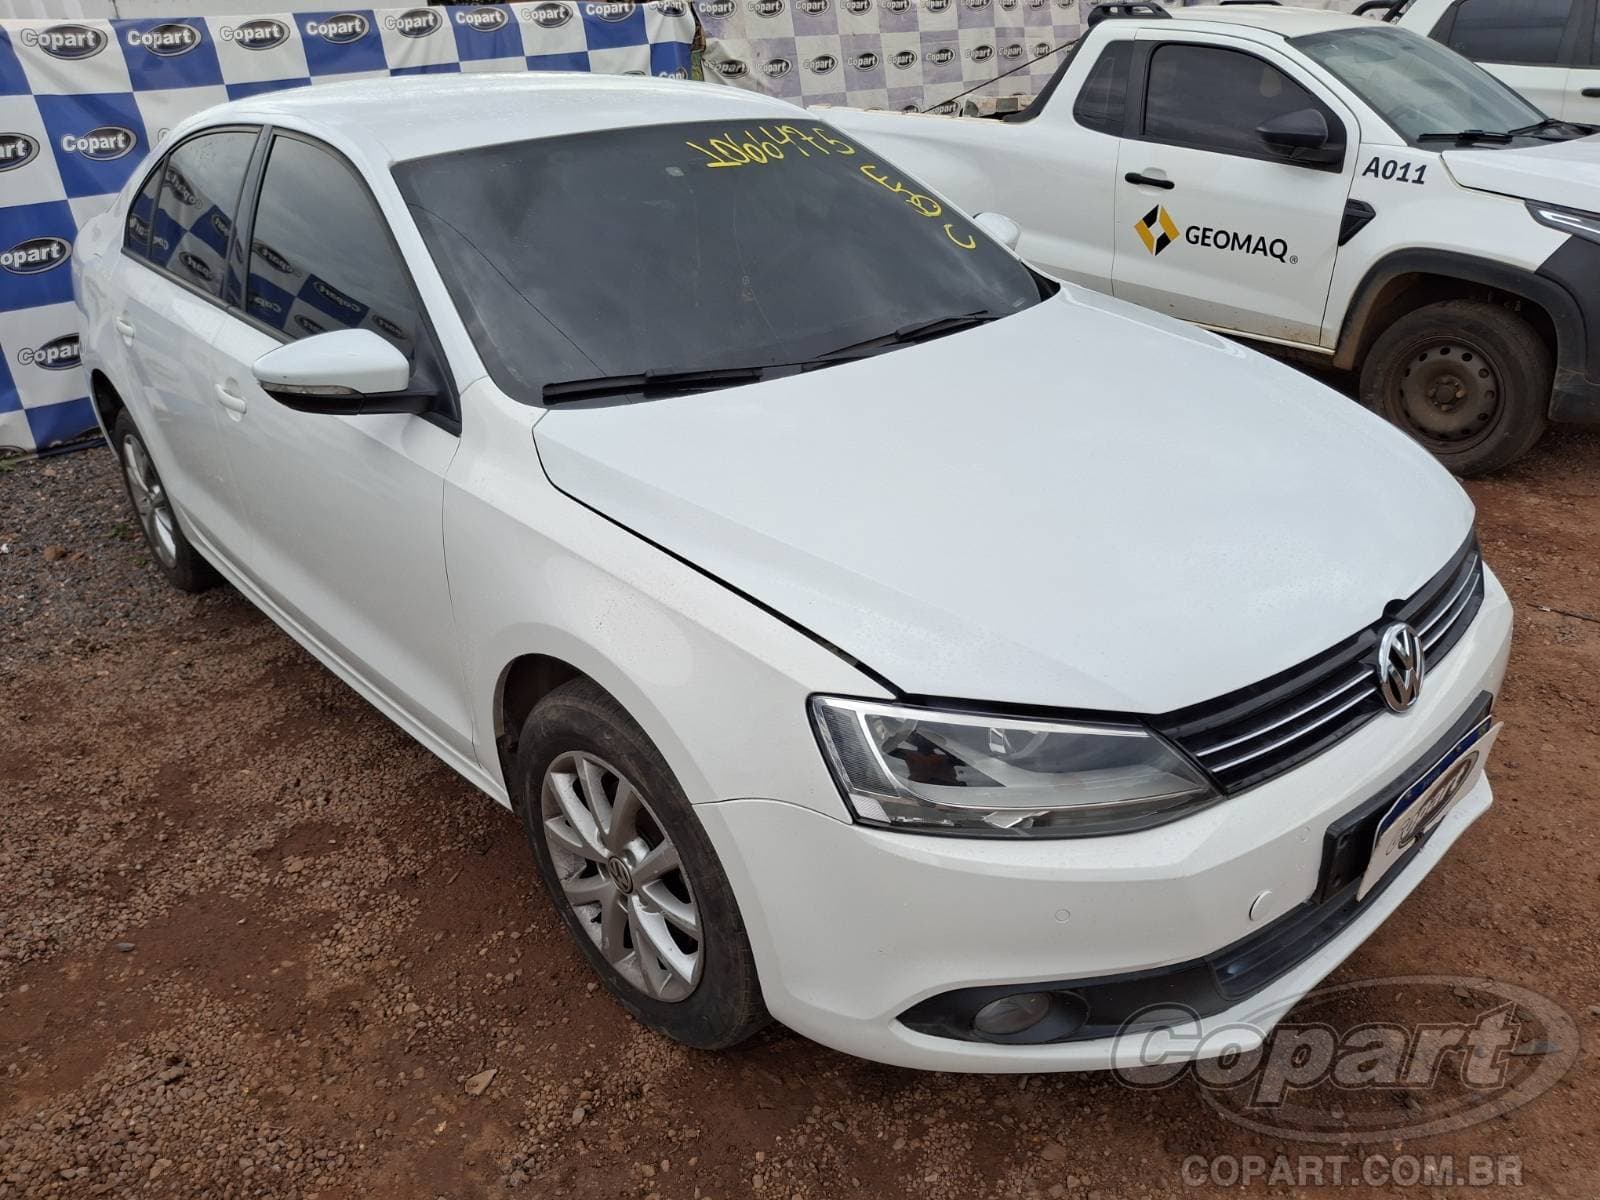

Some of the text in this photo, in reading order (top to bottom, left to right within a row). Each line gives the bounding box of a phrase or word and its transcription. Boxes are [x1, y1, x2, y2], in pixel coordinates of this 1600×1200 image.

[521, 6, 566, 22] Copart
[586, 3, 630, 17] Copart
[700, 0, 734, 13] Copart
[747, 0, 782, 12] Copart
[795, 0, 826, 11] Copart
[384, 13, 434, 31] Copart
[455, 11, 503, 26] Copart
[220, 24, 281, 42] Copart
[305, 18, 361, 38] Copart
[21, 28, 96, 51] Copart
[128, 28, 191, 48] Copart
[847, 56, 876, 68] Copart
[62, 134, 124, 153] Copart
[1361, 156, 1427, 185] A011
[1185, 225, 1288, 263] GEOMAQ
[0, 241, 60, 267] opart
[17, 344, 80, 366] Copar
